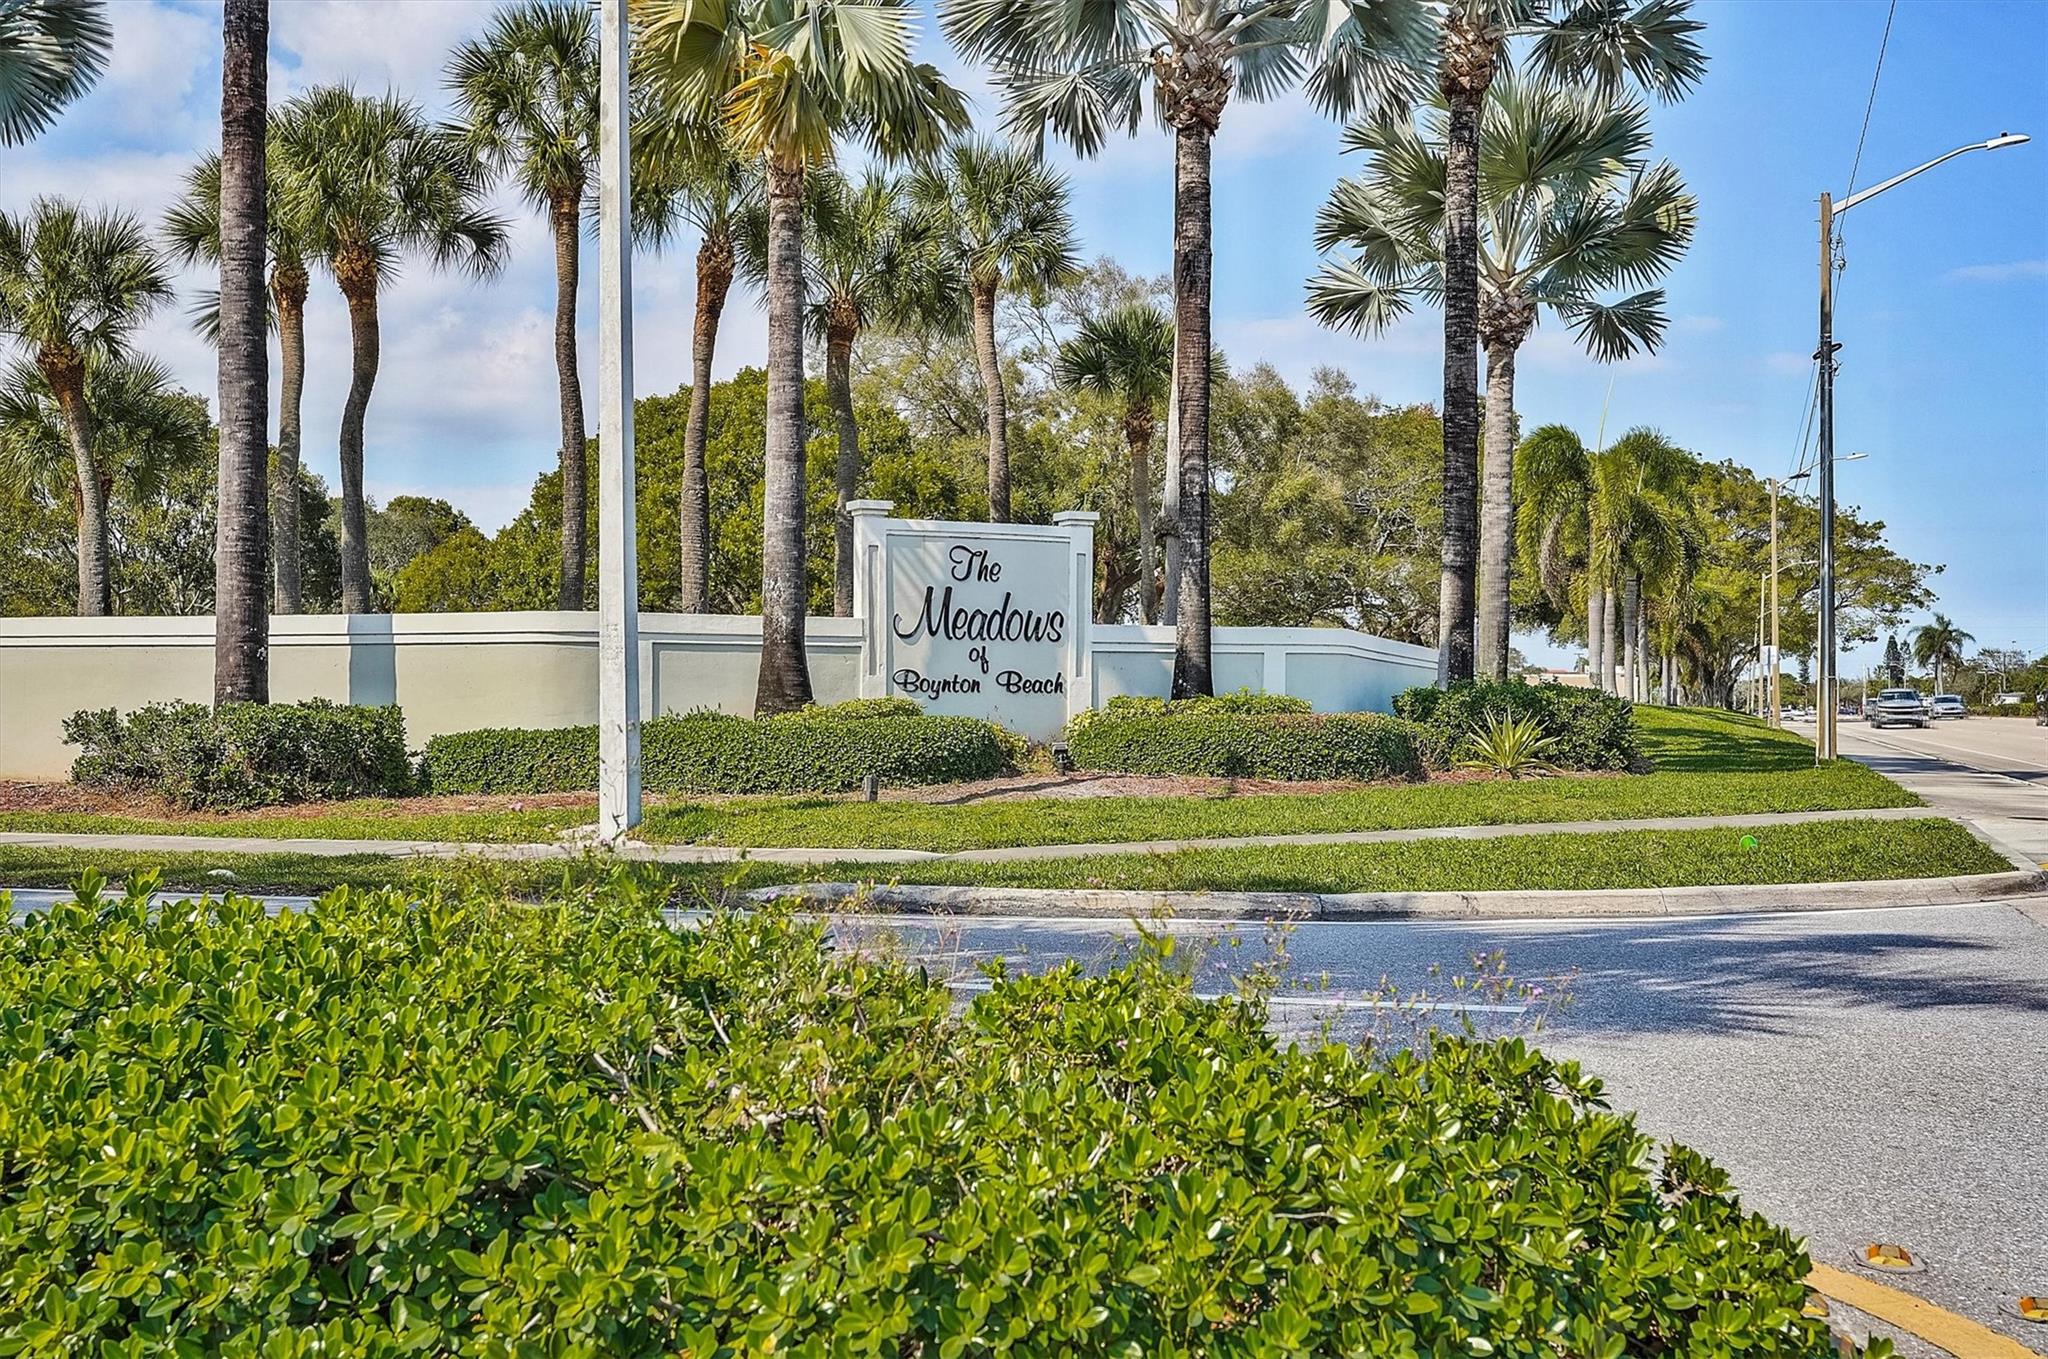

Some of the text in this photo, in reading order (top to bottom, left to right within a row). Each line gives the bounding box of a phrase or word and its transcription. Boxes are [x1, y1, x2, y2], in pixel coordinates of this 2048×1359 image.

[949, 545, 1001, 582] The
[893, 586, 1064, 642] Meadows
[968, 645, 989, 674] of
[892, 669, 1064, 700] Boynton Beach
